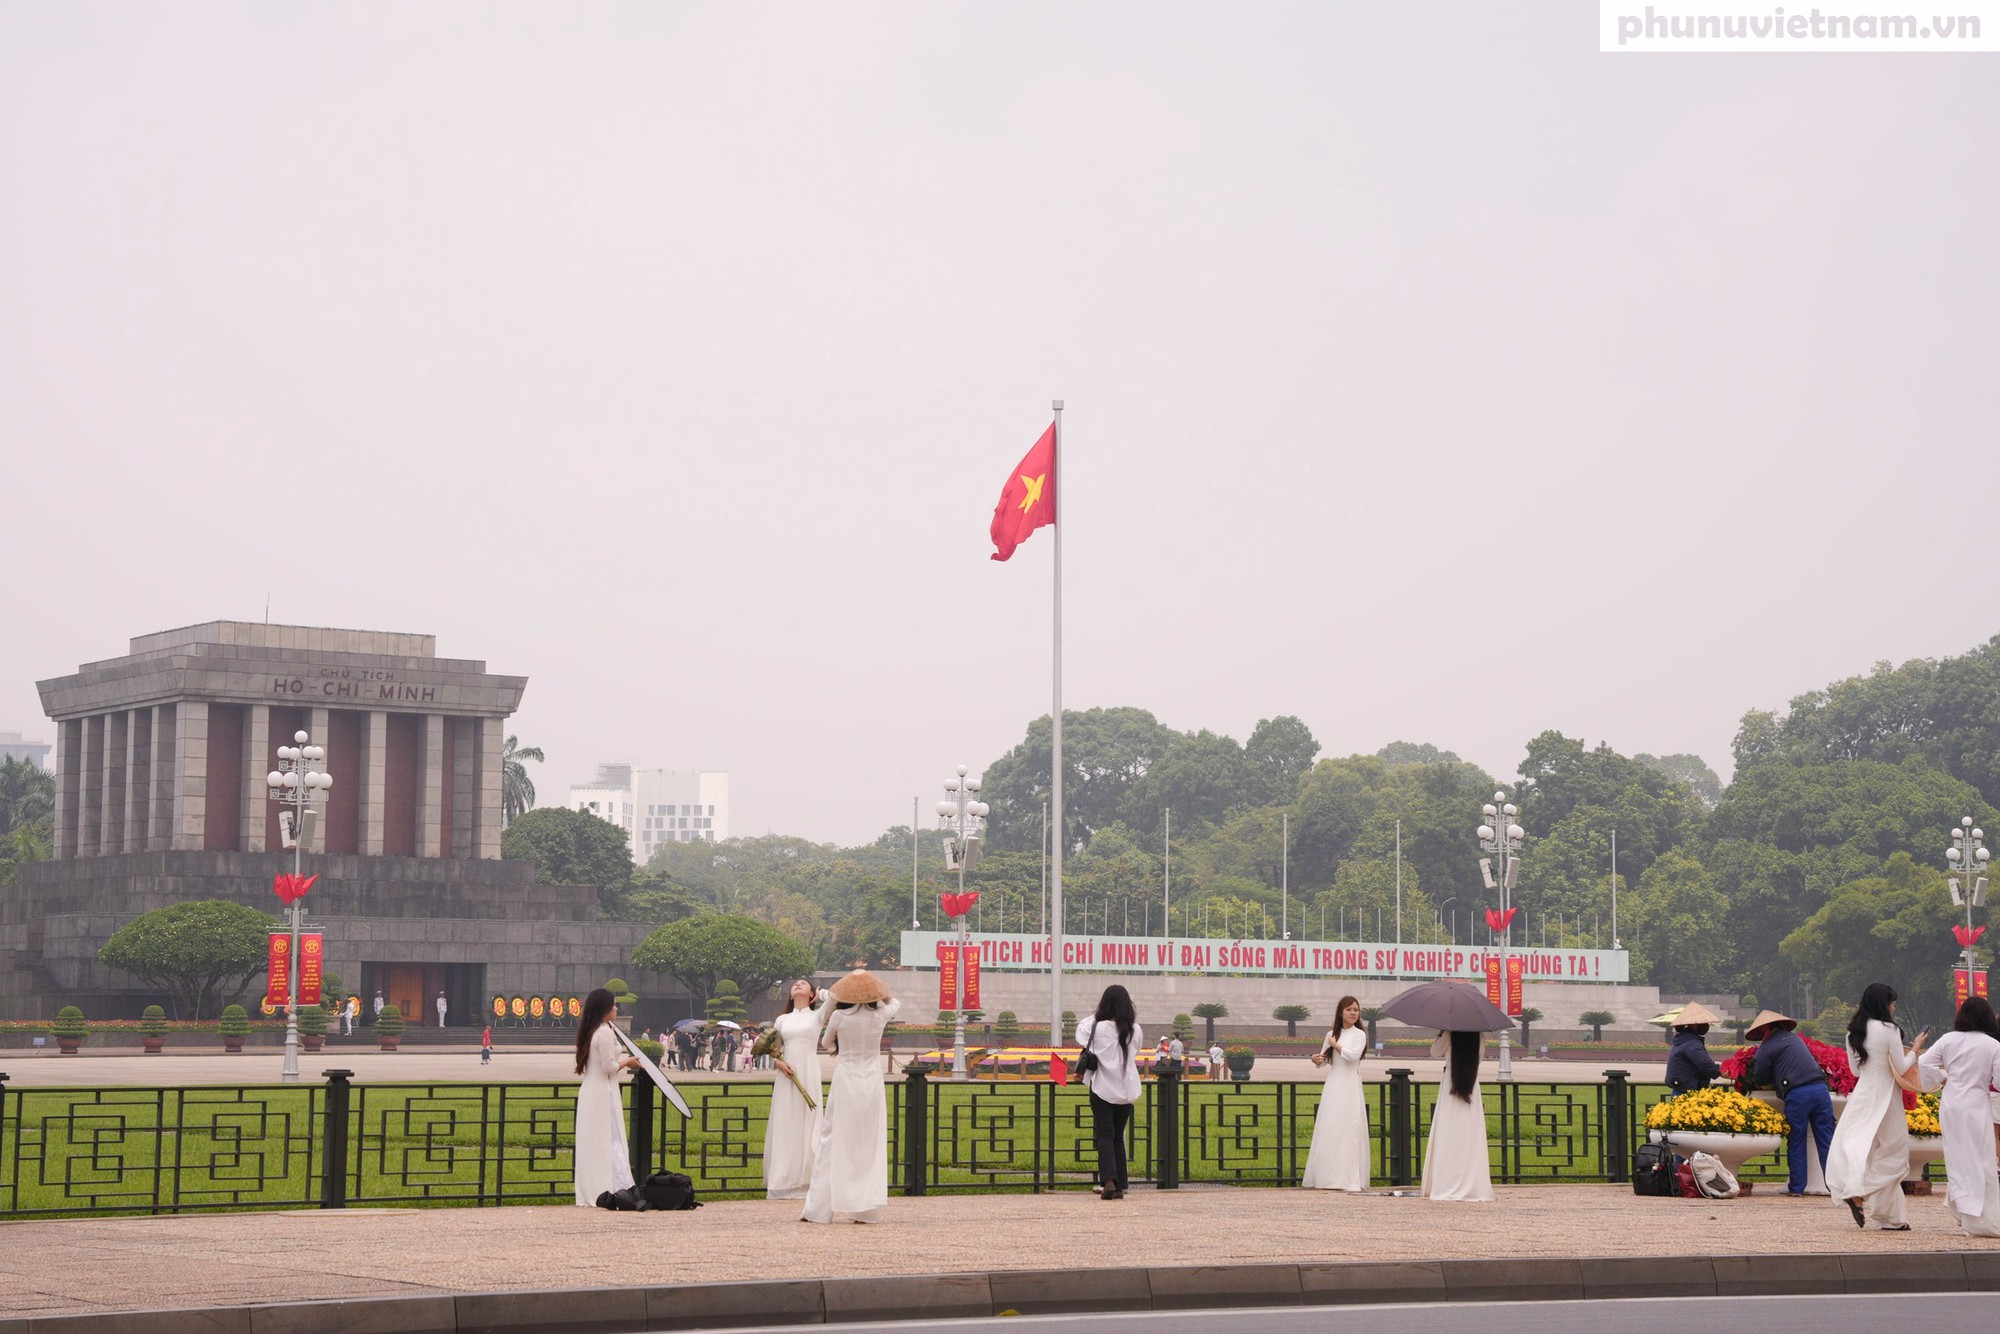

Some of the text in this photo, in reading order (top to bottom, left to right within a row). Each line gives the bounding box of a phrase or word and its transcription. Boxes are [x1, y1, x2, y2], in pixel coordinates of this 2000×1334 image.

[273, 676, 305, 694] HỒ
[983, 940, 1023, 967] TỊCH
[1063, 938, 1094, 965] CHÍ
[1102, 943, 1149, 965] MINH
[1157, 941, 1174, 966] VĨ
[1181, 944, 1211, 970] ĐẠI
[1218, 939, 1266, 968] SỐNG
[1273, 944, 1306, 969] MÃI
[1312, 949, 1369, 971] TRONG
[1375, 948, 1399, 975] SỰ
[1403, 948, 1464, 975] NGHIỆP
[1509, 950, 1563, 975] HÚNG
[1568, 955, 1588, 976] TA
